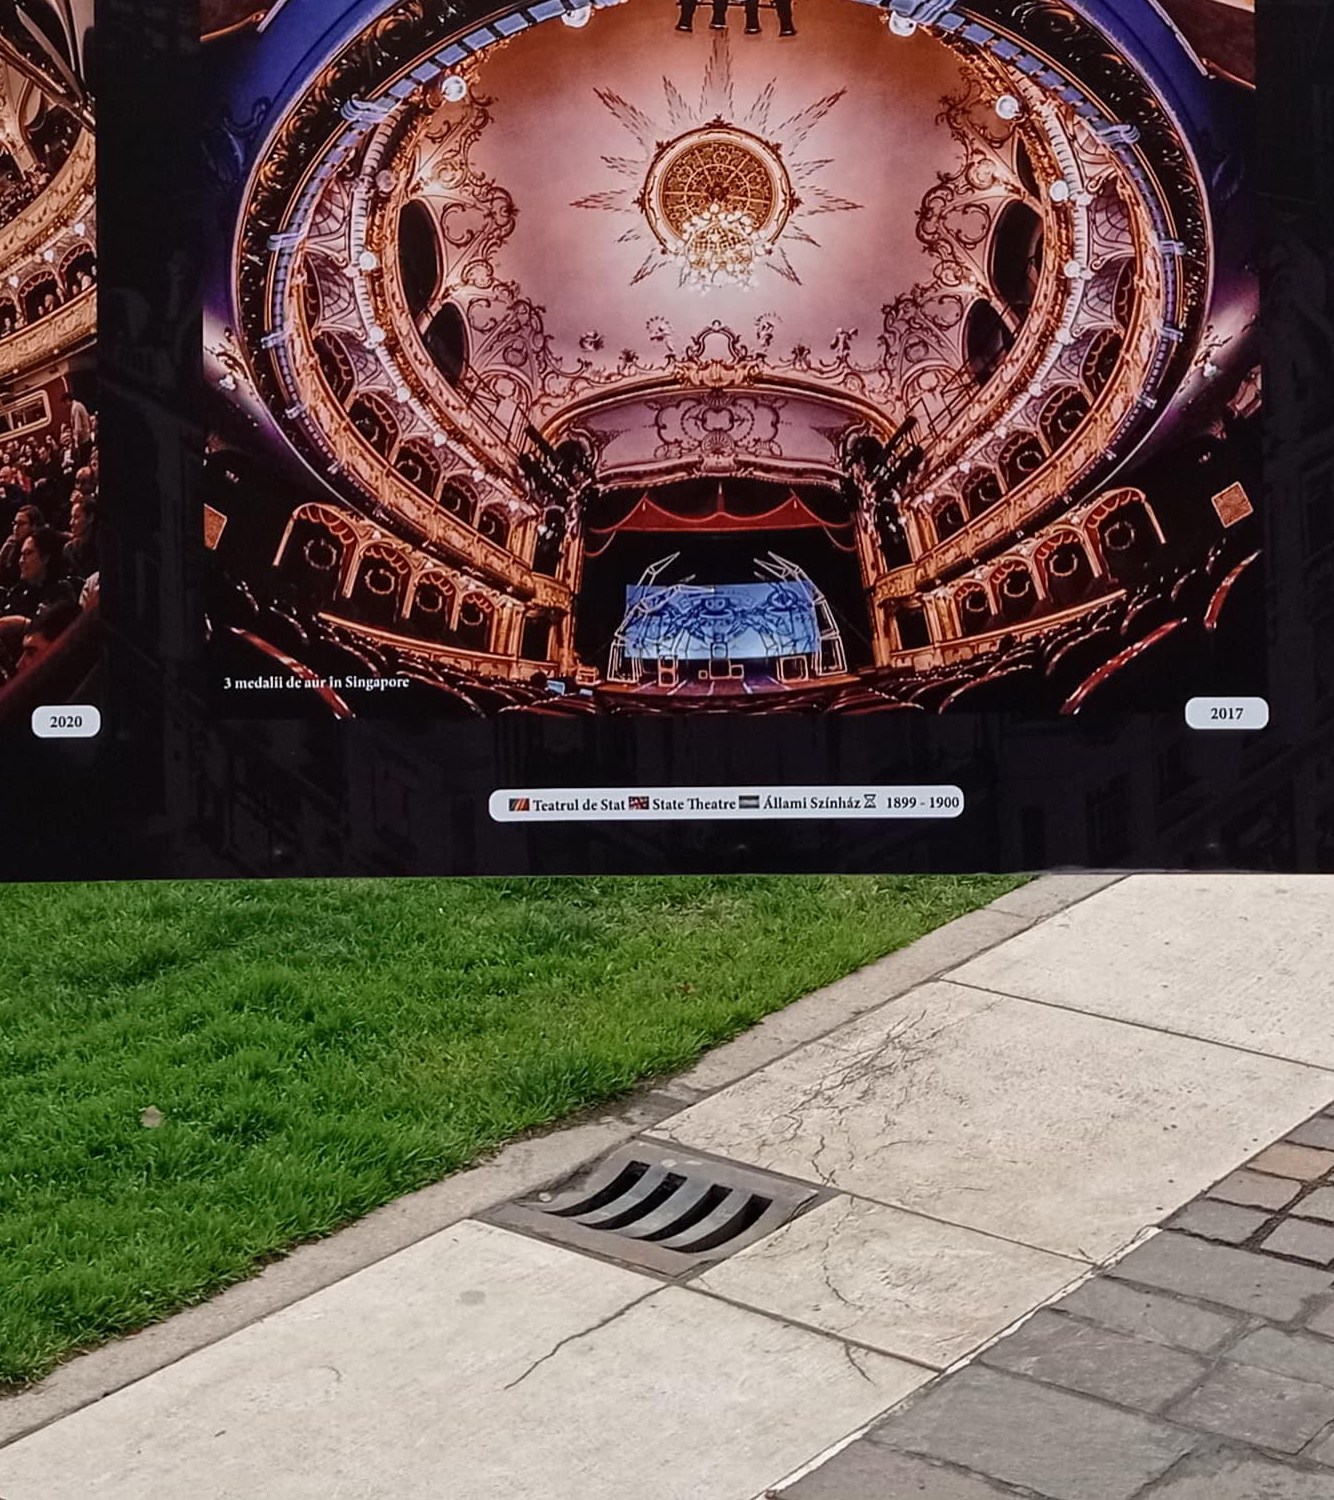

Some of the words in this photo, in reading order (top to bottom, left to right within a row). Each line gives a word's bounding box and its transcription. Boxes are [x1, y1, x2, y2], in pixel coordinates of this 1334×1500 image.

[223, 677, 232, 689] 3
[235, 676, 283, 689] medalii
[286, 676, 301, 688] de
[305, 678, 326, 688] aur
[345, 675, 409, 691] Singapore
[1211, 707, 1244, 720] 2017
[50, 715, 82, 728] 2020
[533, 798, 579, 811] Teatrul
[582, 798, 597, 811] de
[601, 798, 625, 811] Stat
[652, 797, 684, 810] State
[687, 797, 736, 810] Theatre
[763, 795, 807, 809] Állami
[810, 796, 861, 809] Színház
[887, 796, 917, 808] 1899
[929, 796, 960, 808] 1900
